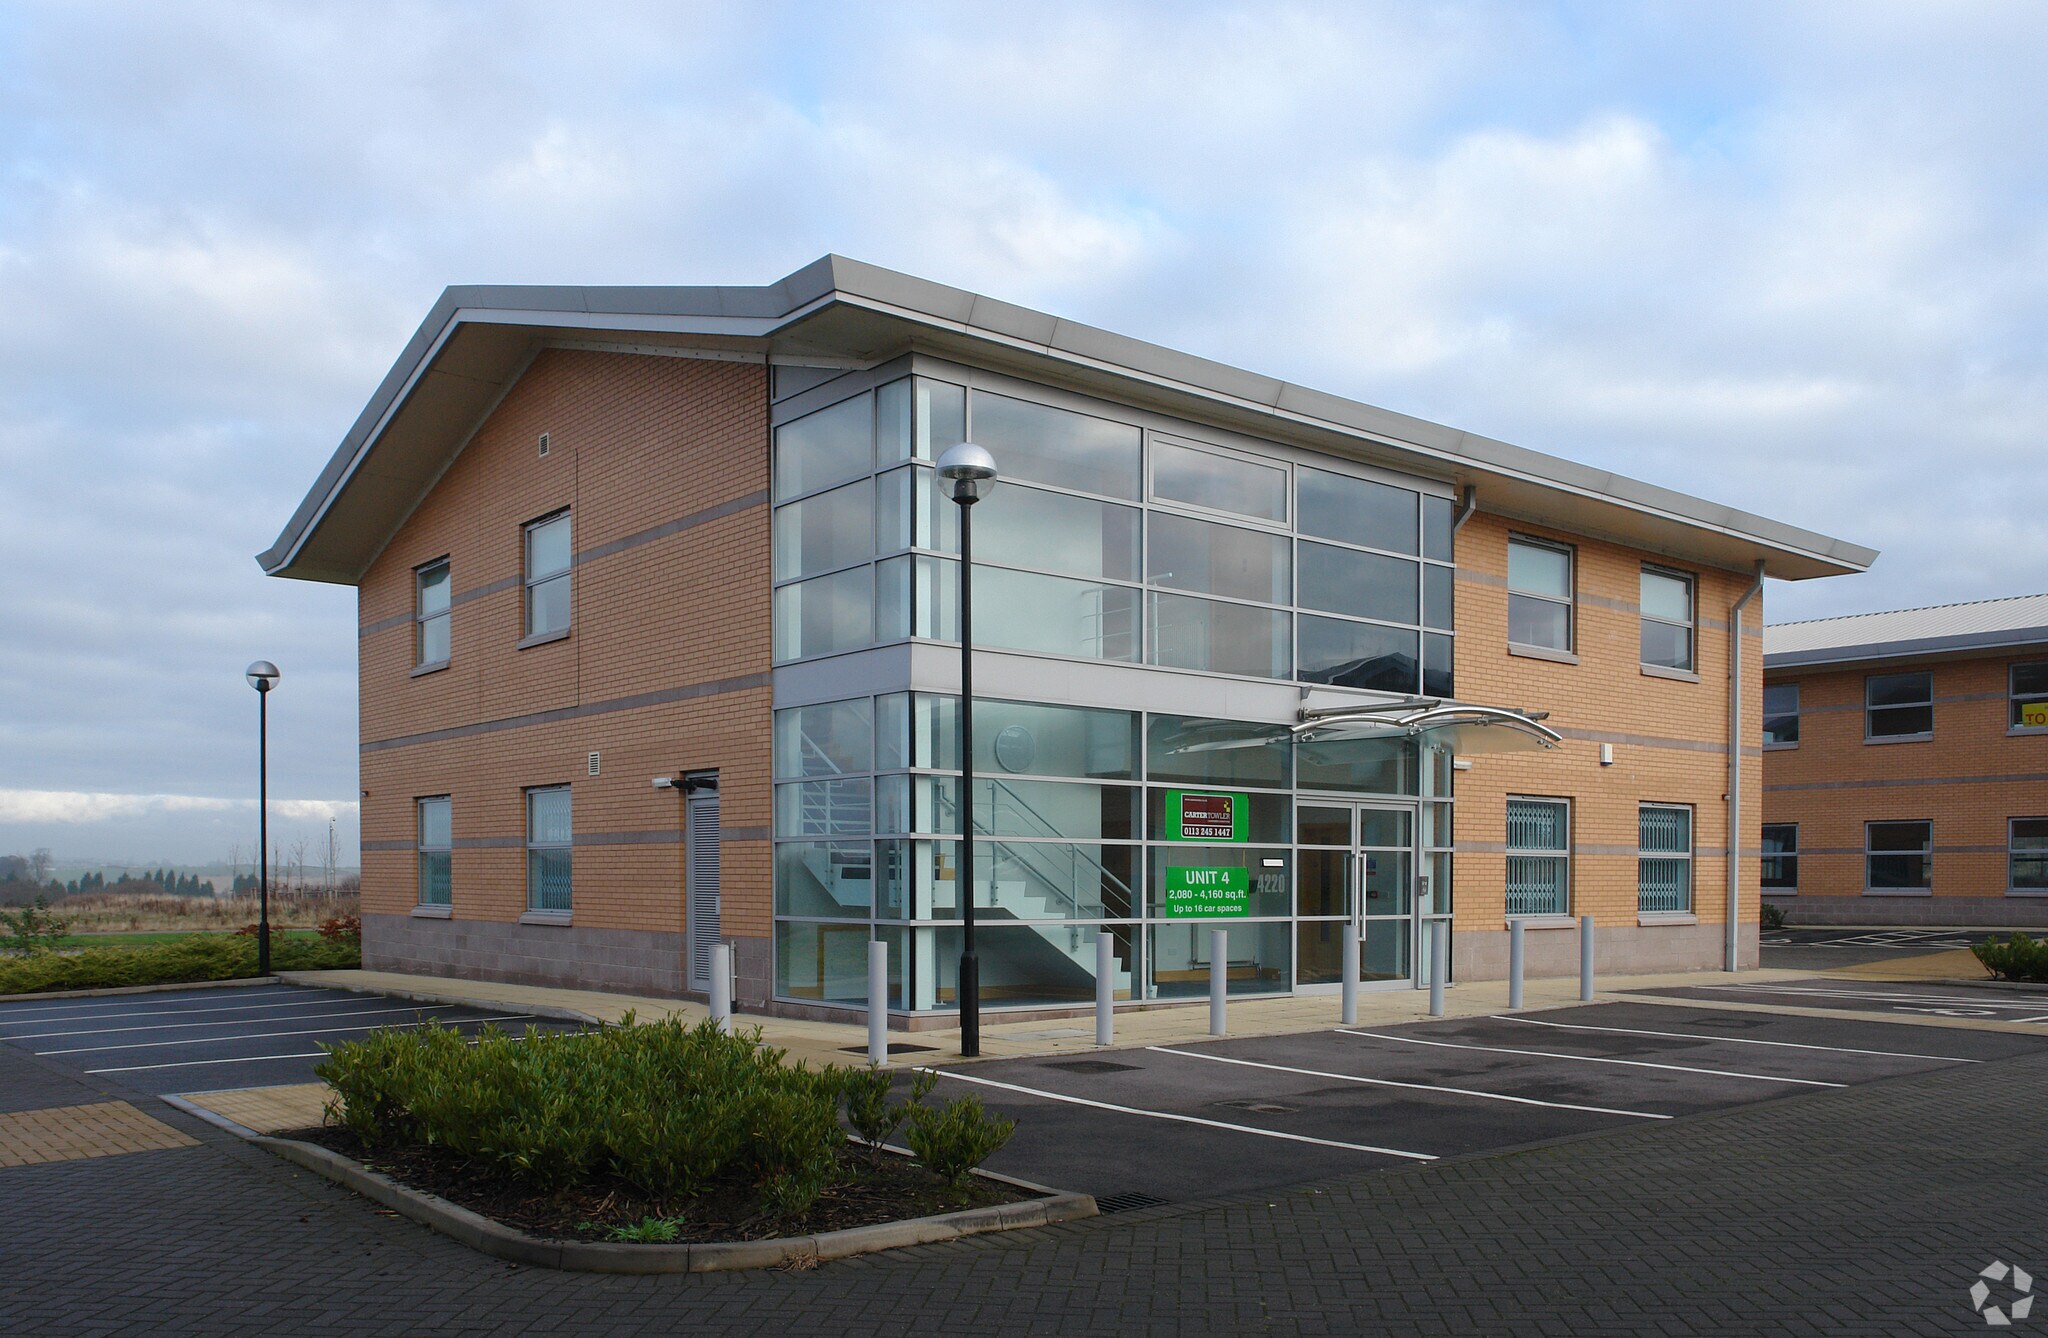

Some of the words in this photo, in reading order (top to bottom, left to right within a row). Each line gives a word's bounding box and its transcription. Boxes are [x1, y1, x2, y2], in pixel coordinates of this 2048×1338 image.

[2025, 712, 2046, 725] TO
[1184, 827, 1199, 835] 0113
[1200, 828, 1213, 836] 245
[1214, 828, 1230, 836] 1447
[1185, 870, 1218, 884] UNIT
[1221, 872, 1230, 884] 4
[1257, 874, 1285, 893] 4220
[1169, 889, 1193, 900] 2,080
[1199, 889, 1223, 900] 4,160
[1225, 889, 1246, 901] sq.ft.
[1173, 904, 1184, 914] Up
[1217, 905, 1242, 914] spaces
